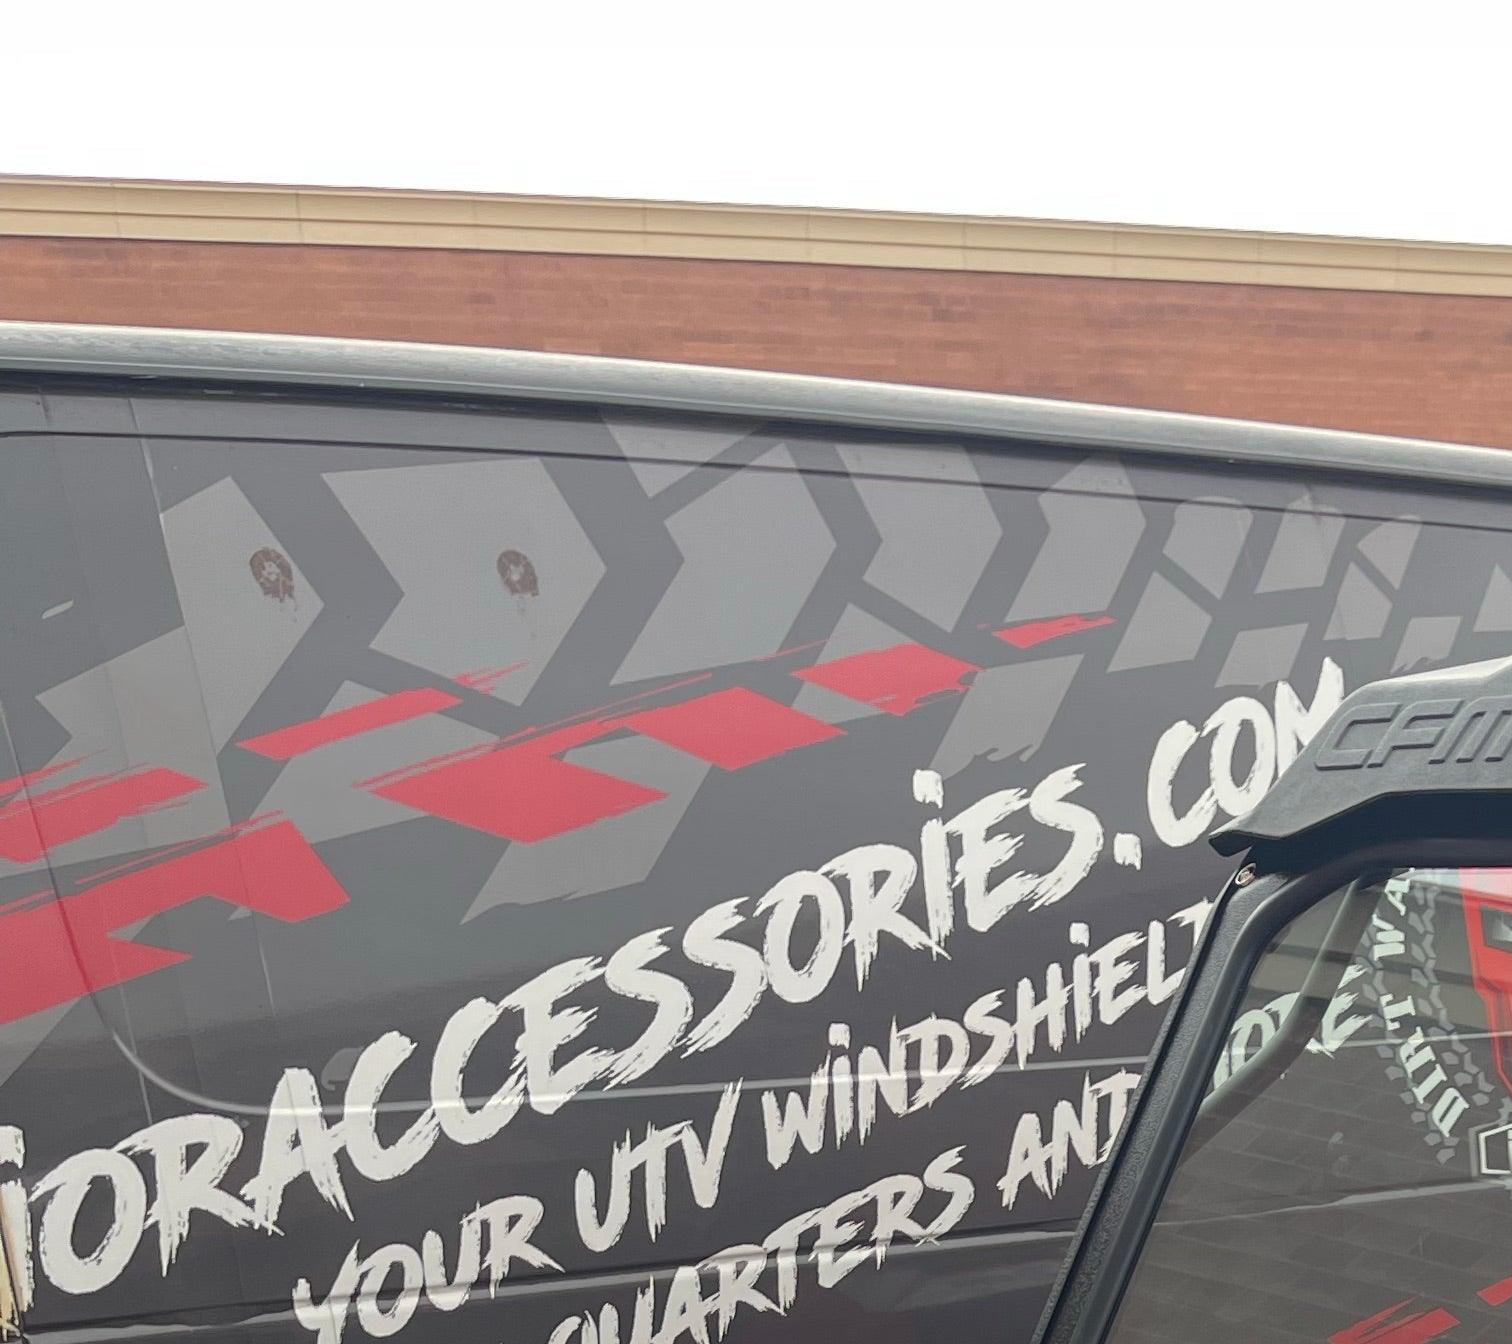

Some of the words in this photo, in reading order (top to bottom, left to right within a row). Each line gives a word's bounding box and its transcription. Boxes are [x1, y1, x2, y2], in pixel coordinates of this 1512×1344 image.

[1373, 868, 1416, 962] WA
[1380, 994, 1470, 1137] DIRT
[574, 1077, 745, 1253] UTV
